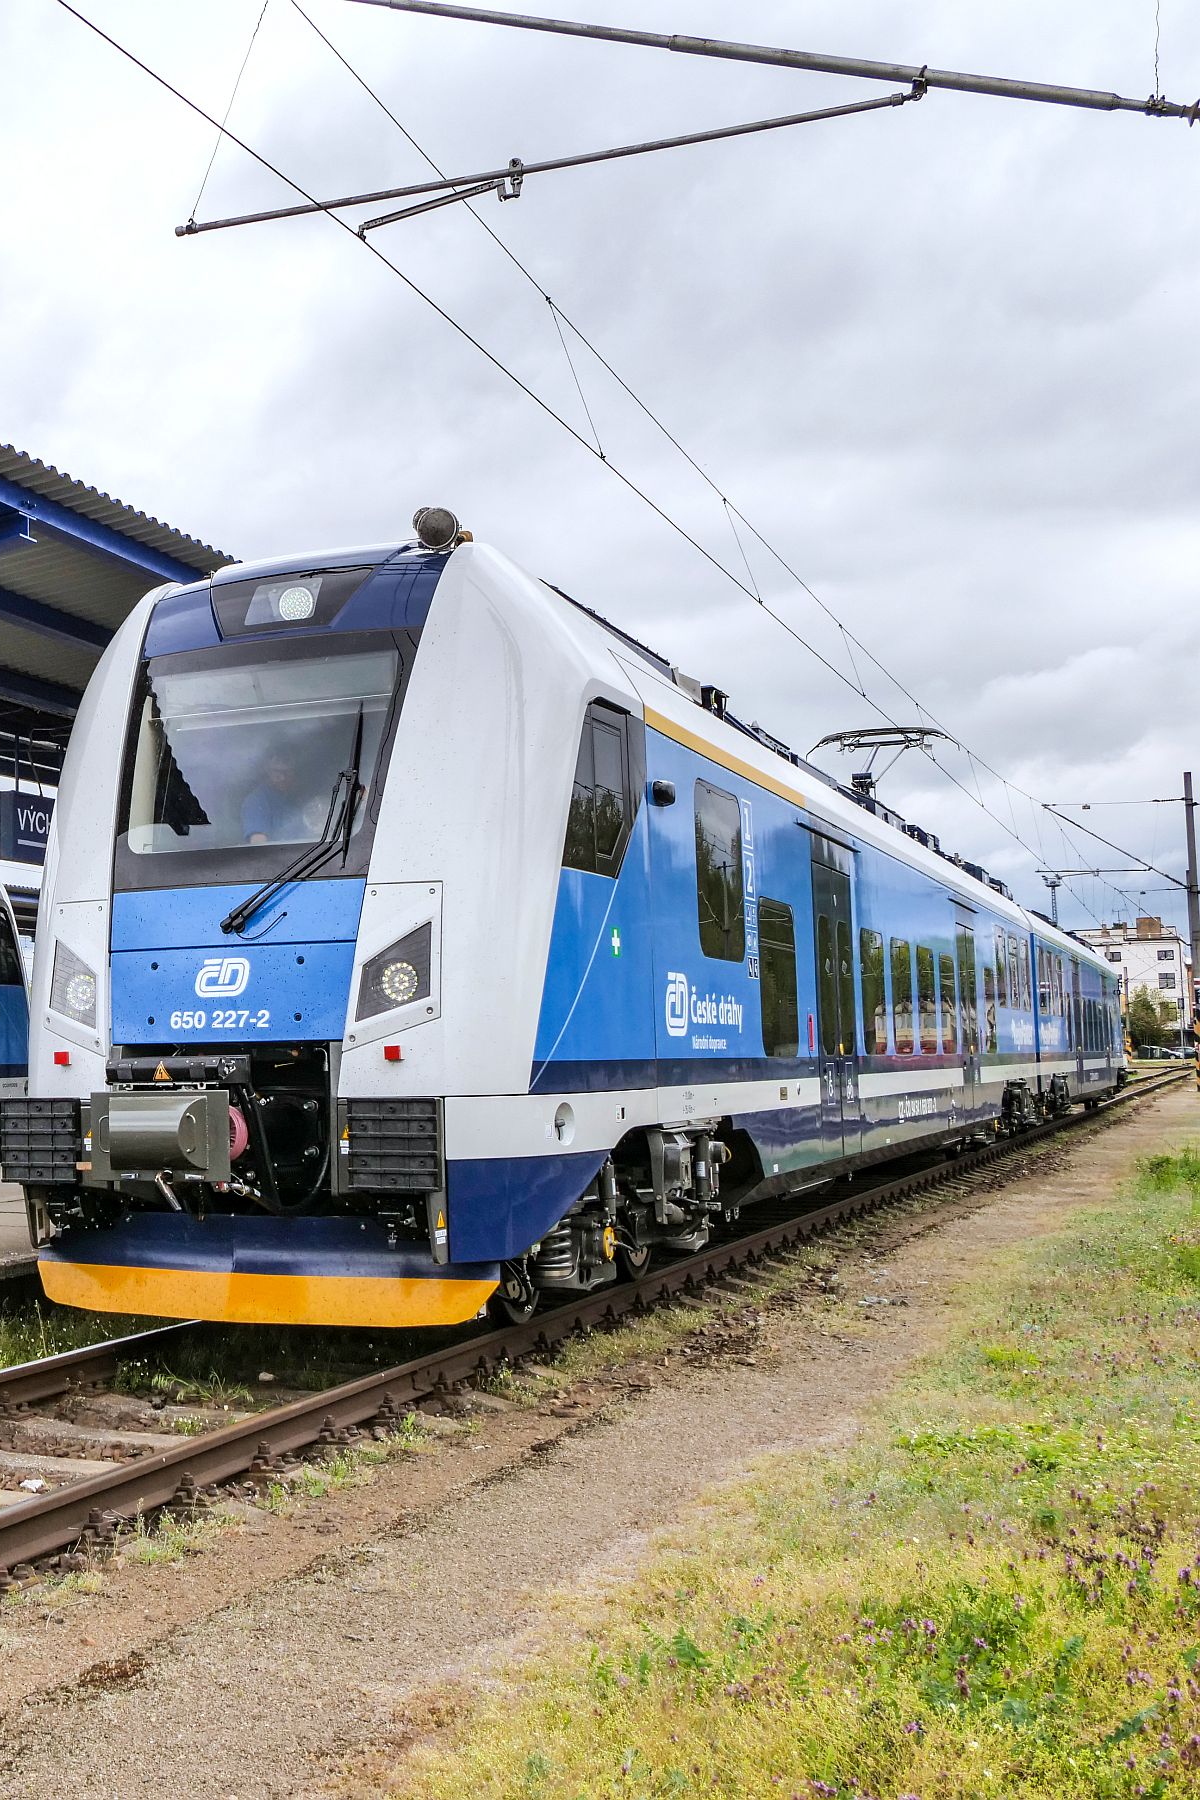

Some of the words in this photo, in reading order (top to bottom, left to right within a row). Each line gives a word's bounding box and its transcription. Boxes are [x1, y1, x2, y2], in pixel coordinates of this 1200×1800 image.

[743, 807, 751, 841] 1
[746, 859, 753, 893] 2
[170, 1010, 206, 1029] 650
[211, 1009, 270, 1029] 227-2
[690, 985, 717, 1025] České
[718, 994, 743, 1034] dráhy
